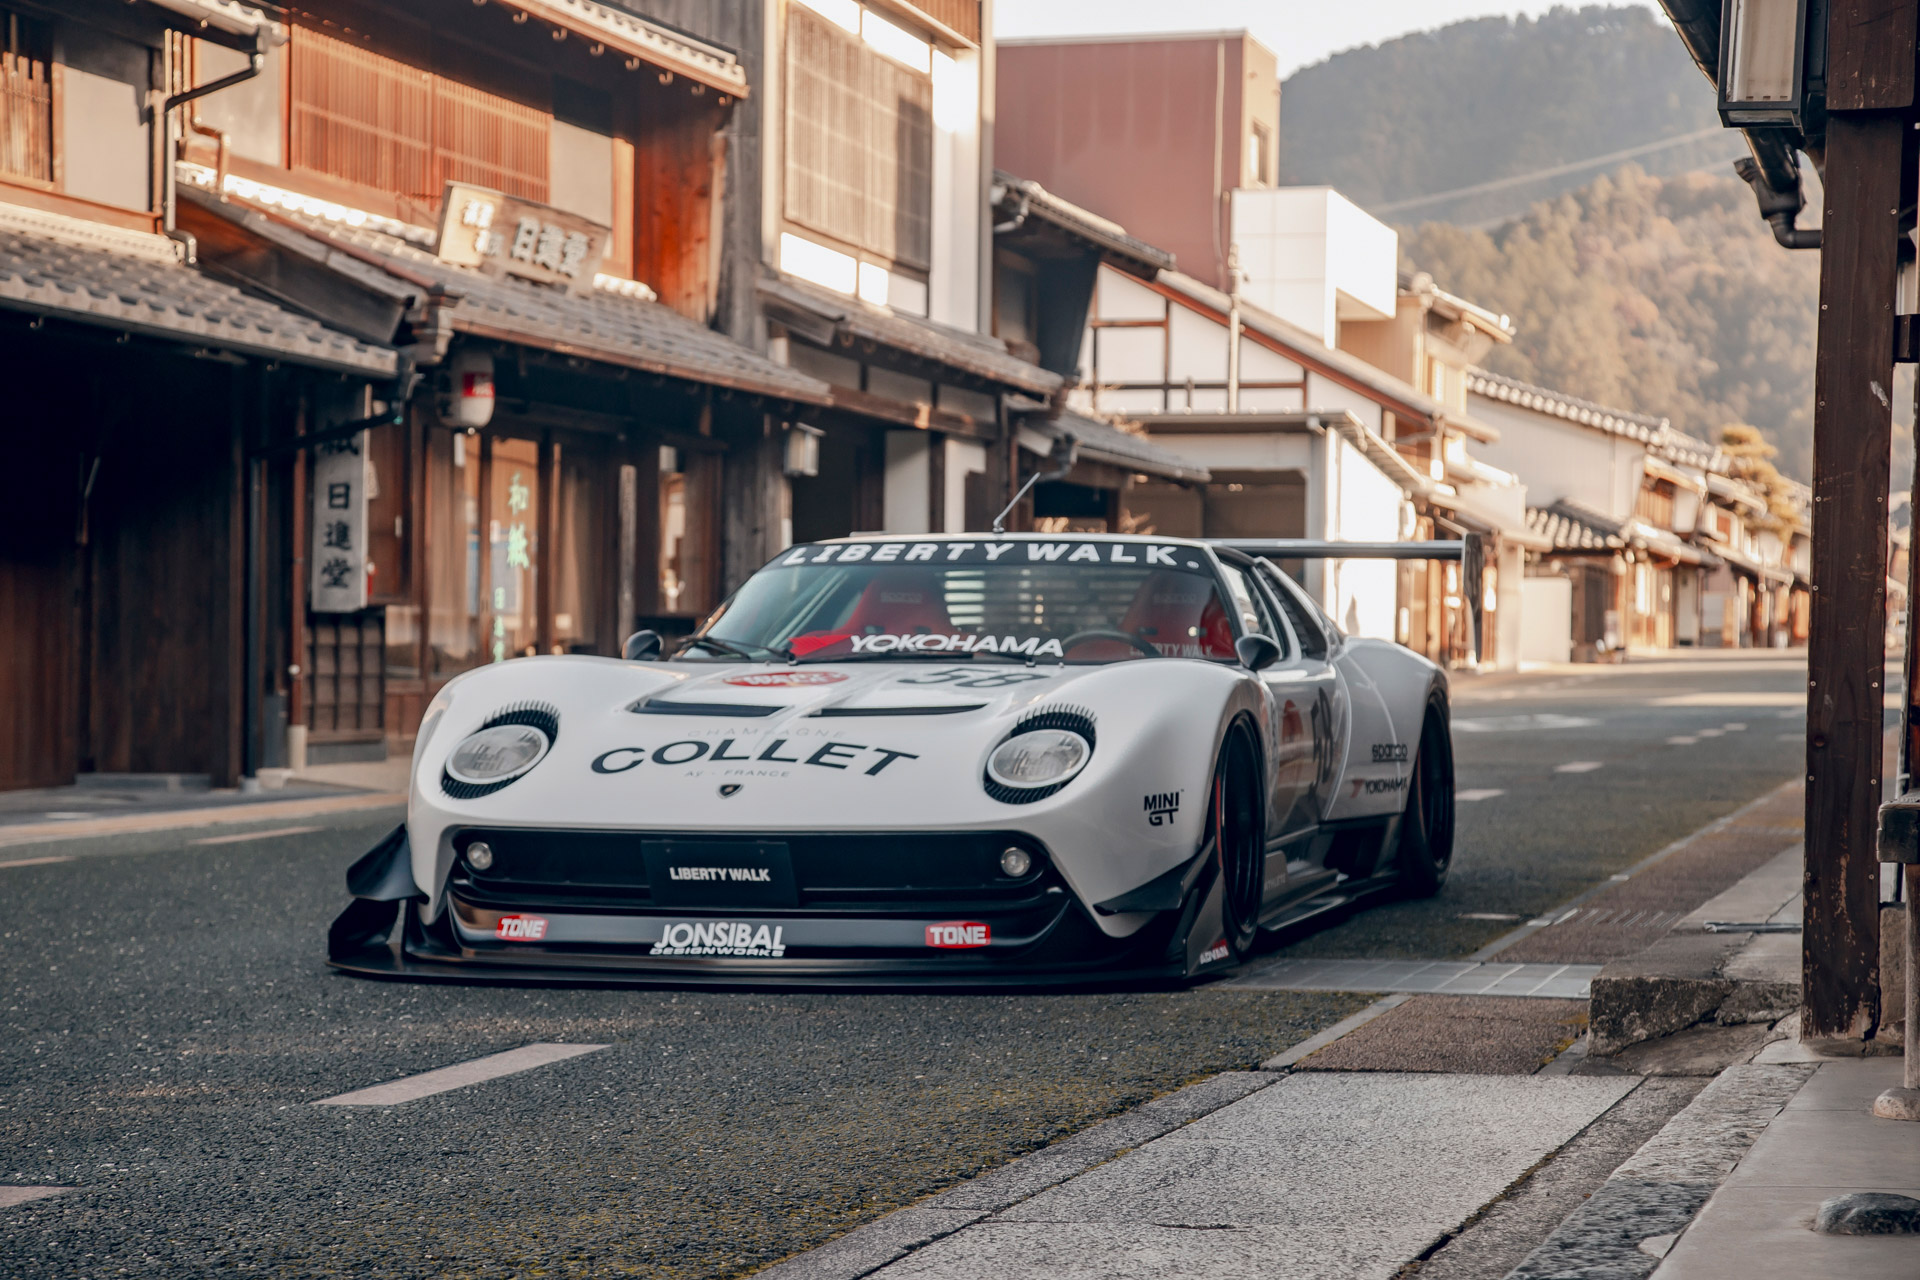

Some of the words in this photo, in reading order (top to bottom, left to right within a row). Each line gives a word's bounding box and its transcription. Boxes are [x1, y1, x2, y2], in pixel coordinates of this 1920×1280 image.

[320, 482, 353, 589] 日進堂
[782, 543, 1015, 566] LIBERTY
[1027, 543, 1178, 566] WALK
[850, 633, 1064, 657] YOKOHAMA
[897, 667, 1050, 688] 58
[590, 738, 920, 776] COLLET
[1372, 744, 1408, 760] sparco
[724, 769, 791, 779] FRANCE
[1143, 791, 1180, 812] MINI
[1149, 808, 1179, 826] GT
[669, 866, 727, 881] LIBERTY
[727, 867, 771, 882] WALK
[500, 918, 546, 938] TONE
[653, 922, 786, 950] JONSIBAL
[929, 925, 987, 945] TONE
[650, 947, 785, 958] DESIGNWORKS
[1199, 945, 1229, 965] ADVAN
